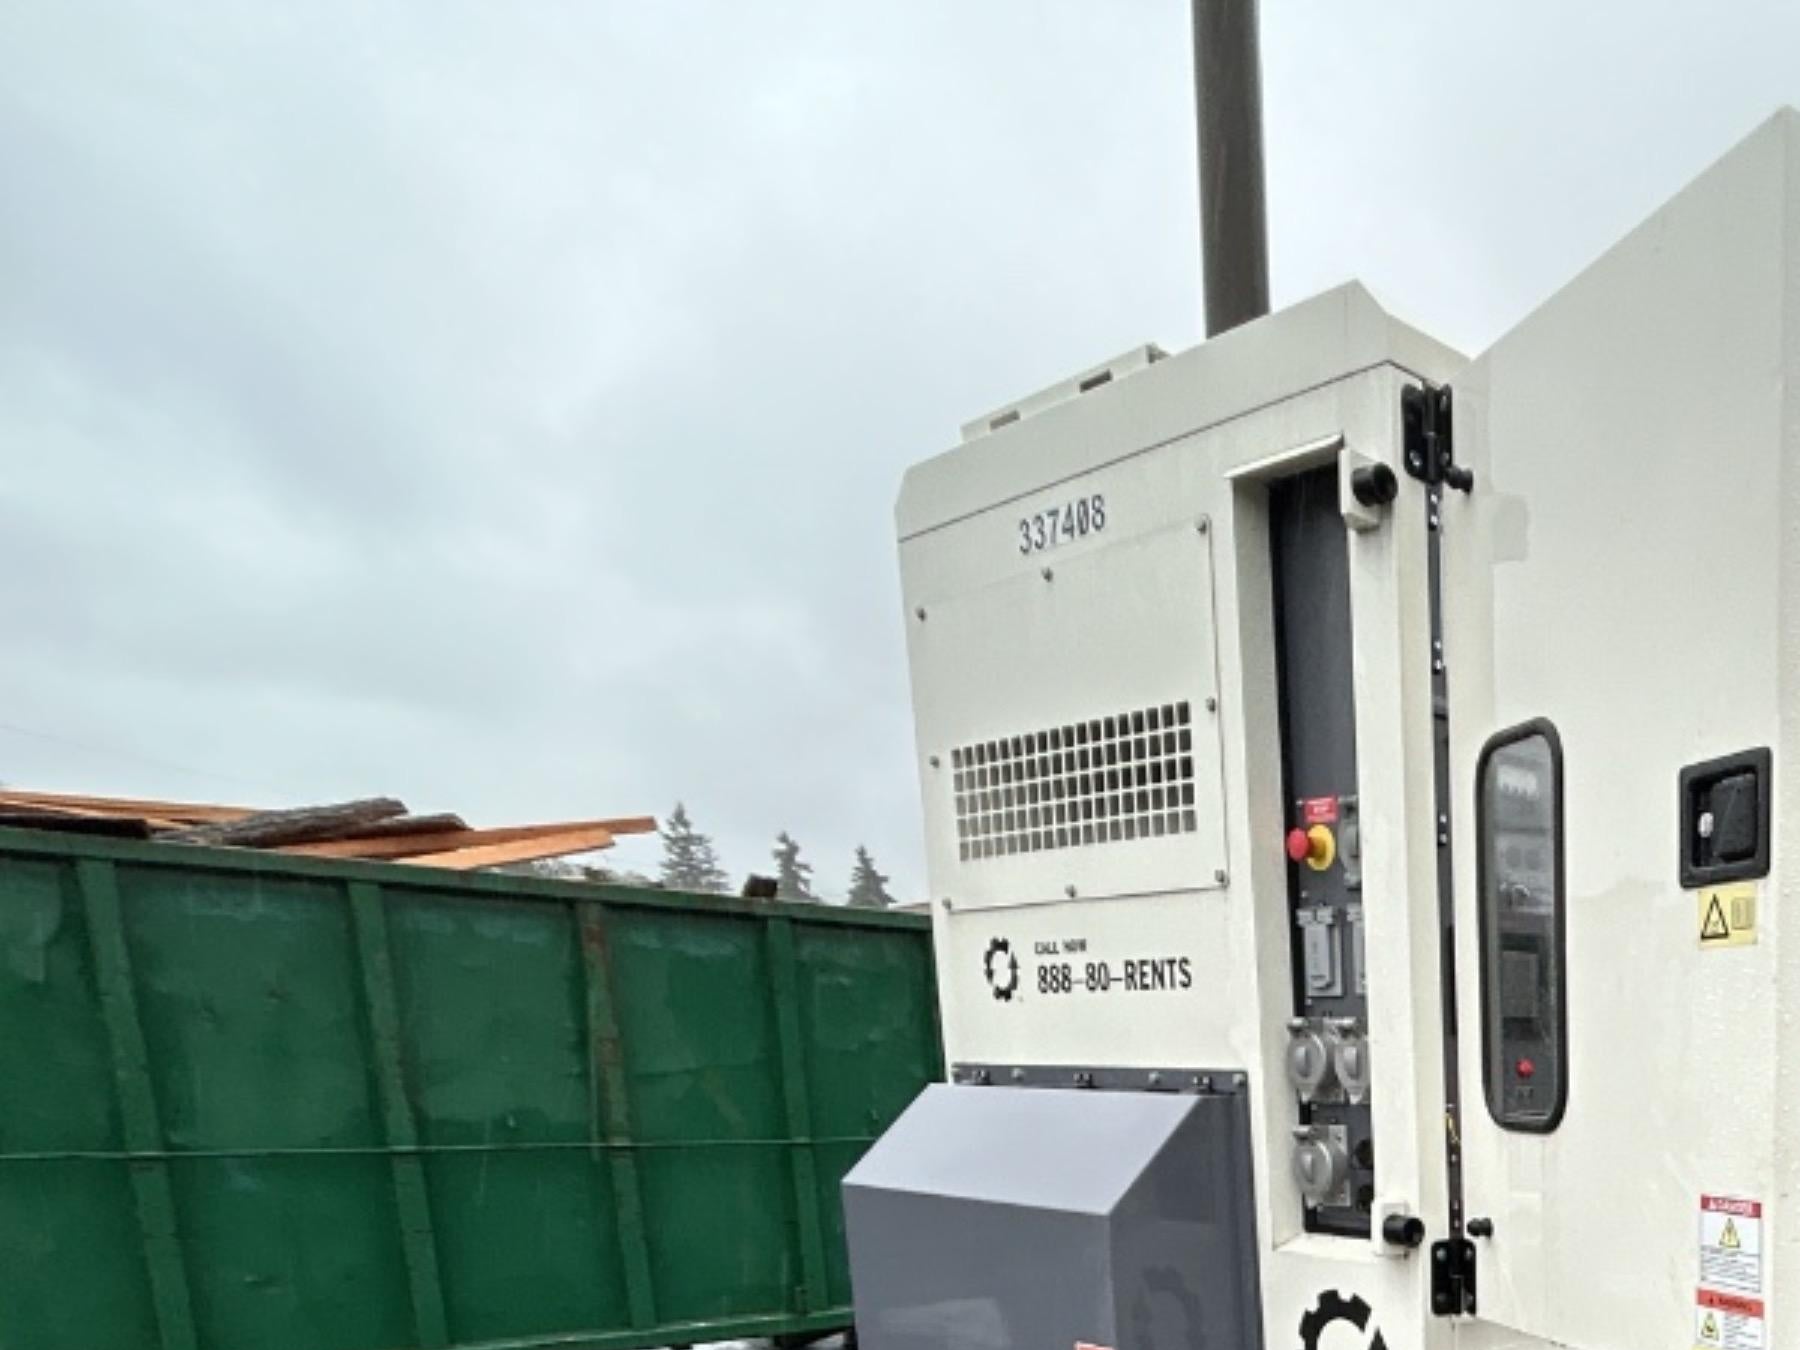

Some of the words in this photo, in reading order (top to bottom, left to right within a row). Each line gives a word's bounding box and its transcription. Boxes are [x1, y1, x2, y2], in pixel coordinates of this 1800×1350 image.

[1019, 493, 1105, 555] 337408
[1034, 940, 1060, 955] CALL
[1062, 937, 1087, 953] NOW
[1036, 956, 1193, 994] 888-80-RENTS
